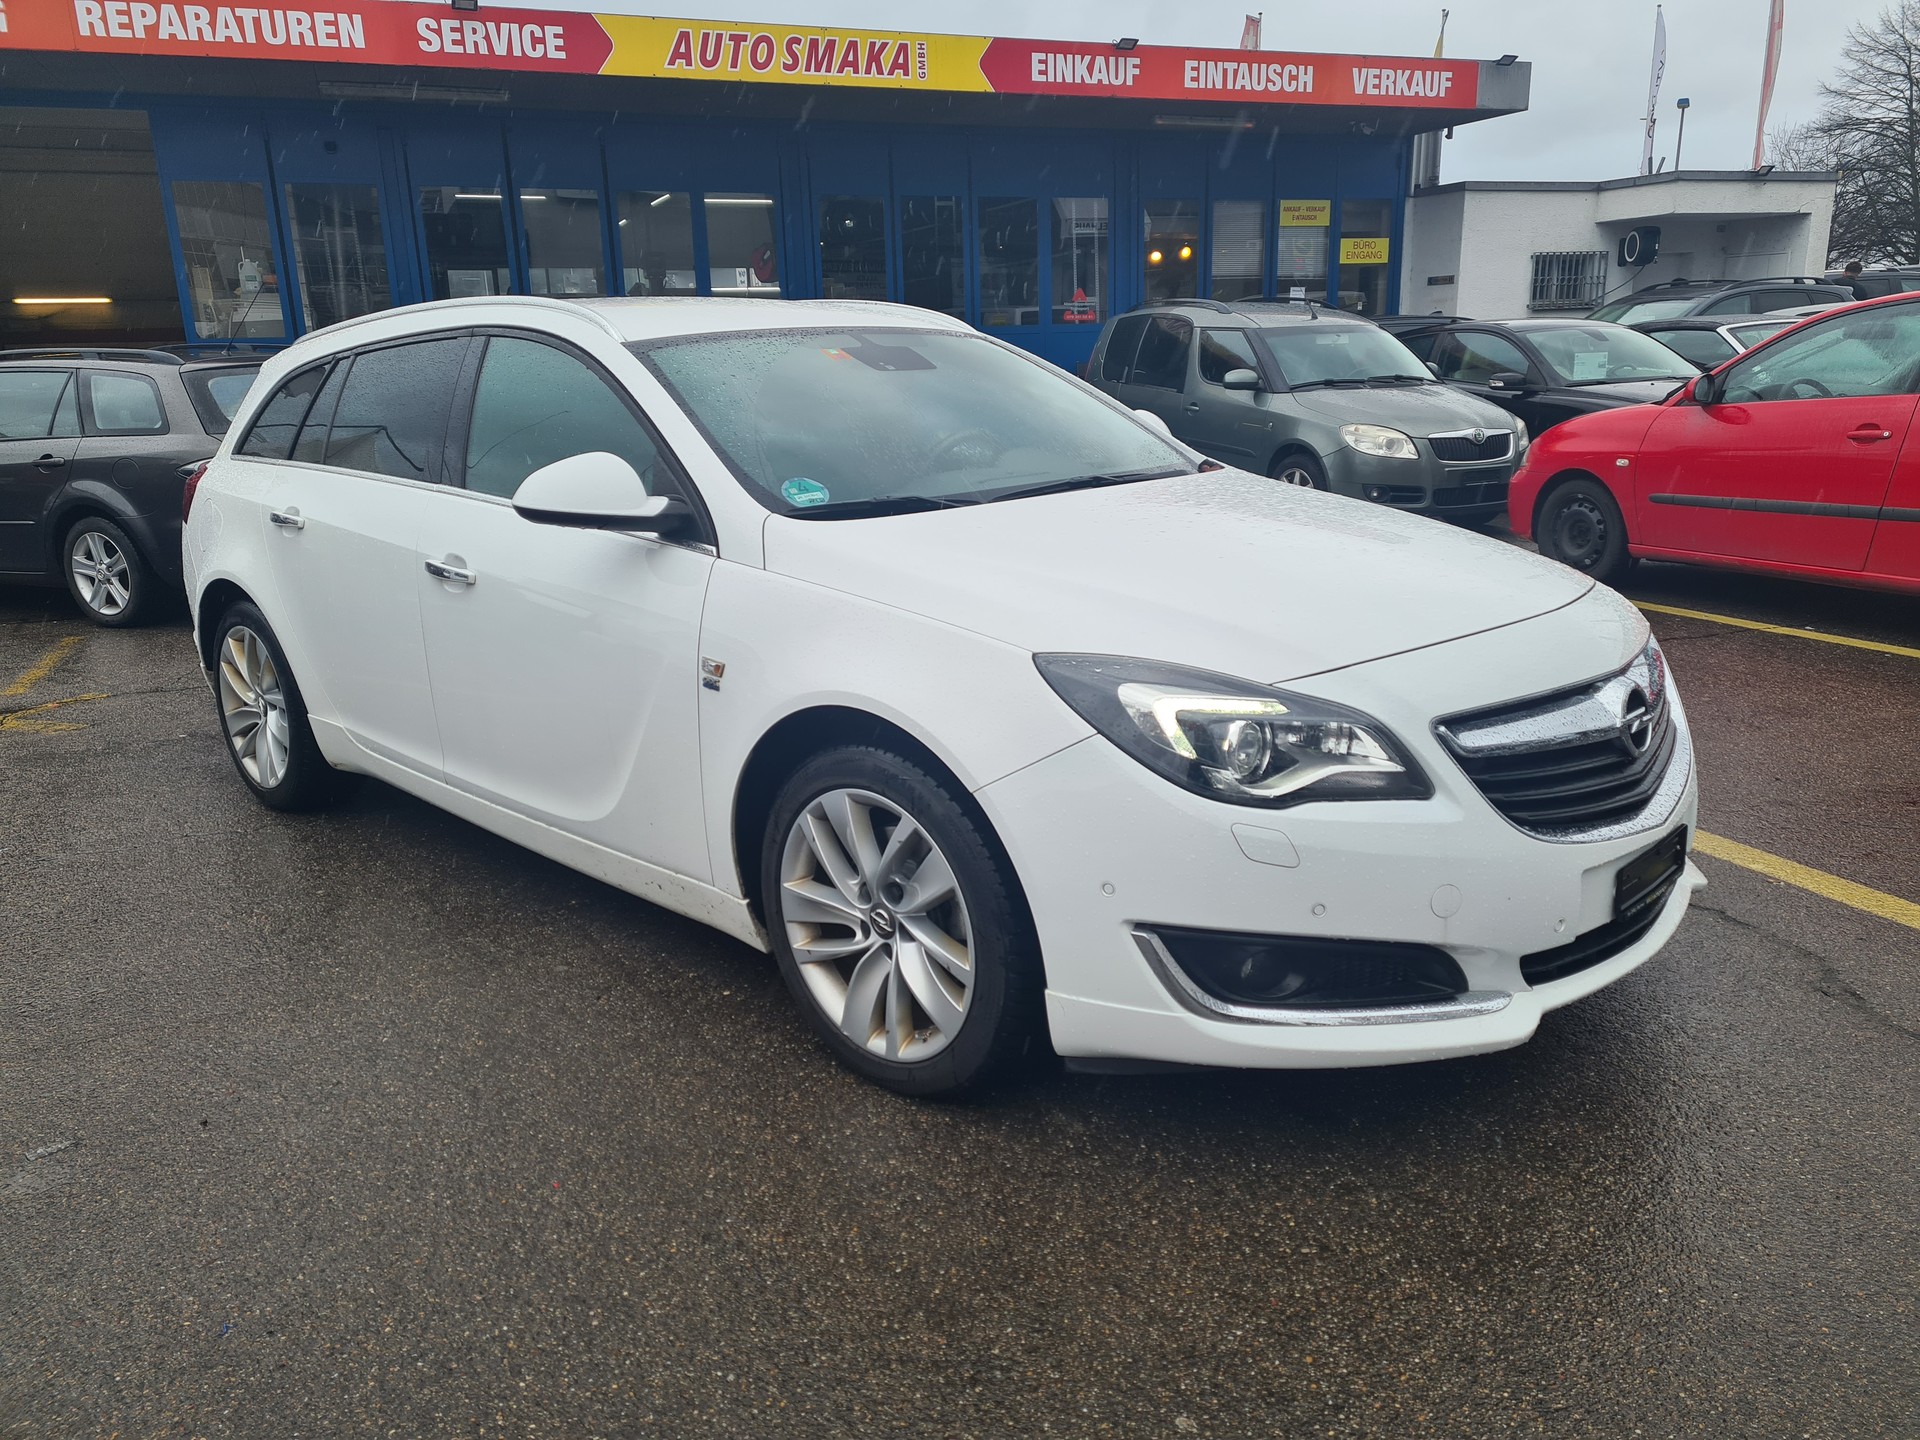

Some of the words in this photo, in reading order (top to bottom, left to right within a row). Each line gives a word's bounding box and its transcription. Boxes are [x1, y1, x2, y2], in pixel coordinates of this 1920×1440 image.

[74, 0, 366, 49] REPARATUREN
[416, 17, 567, 60] SERVICE
[666, 29, 776, 72] AUTO
[782, 36, 911, 78] SMAKA
[916, 41, 927, 79] GMBH
[1031, 52, 1141, 86] EINKAUF
[1184, 59, 1314, 93] EINTAUSCH
[1352, 67, 1453, 98] VERKAUF
[1346, 251, 1382, 260] EINGANG
[1353, 240, 1376, 250] BÜRO
